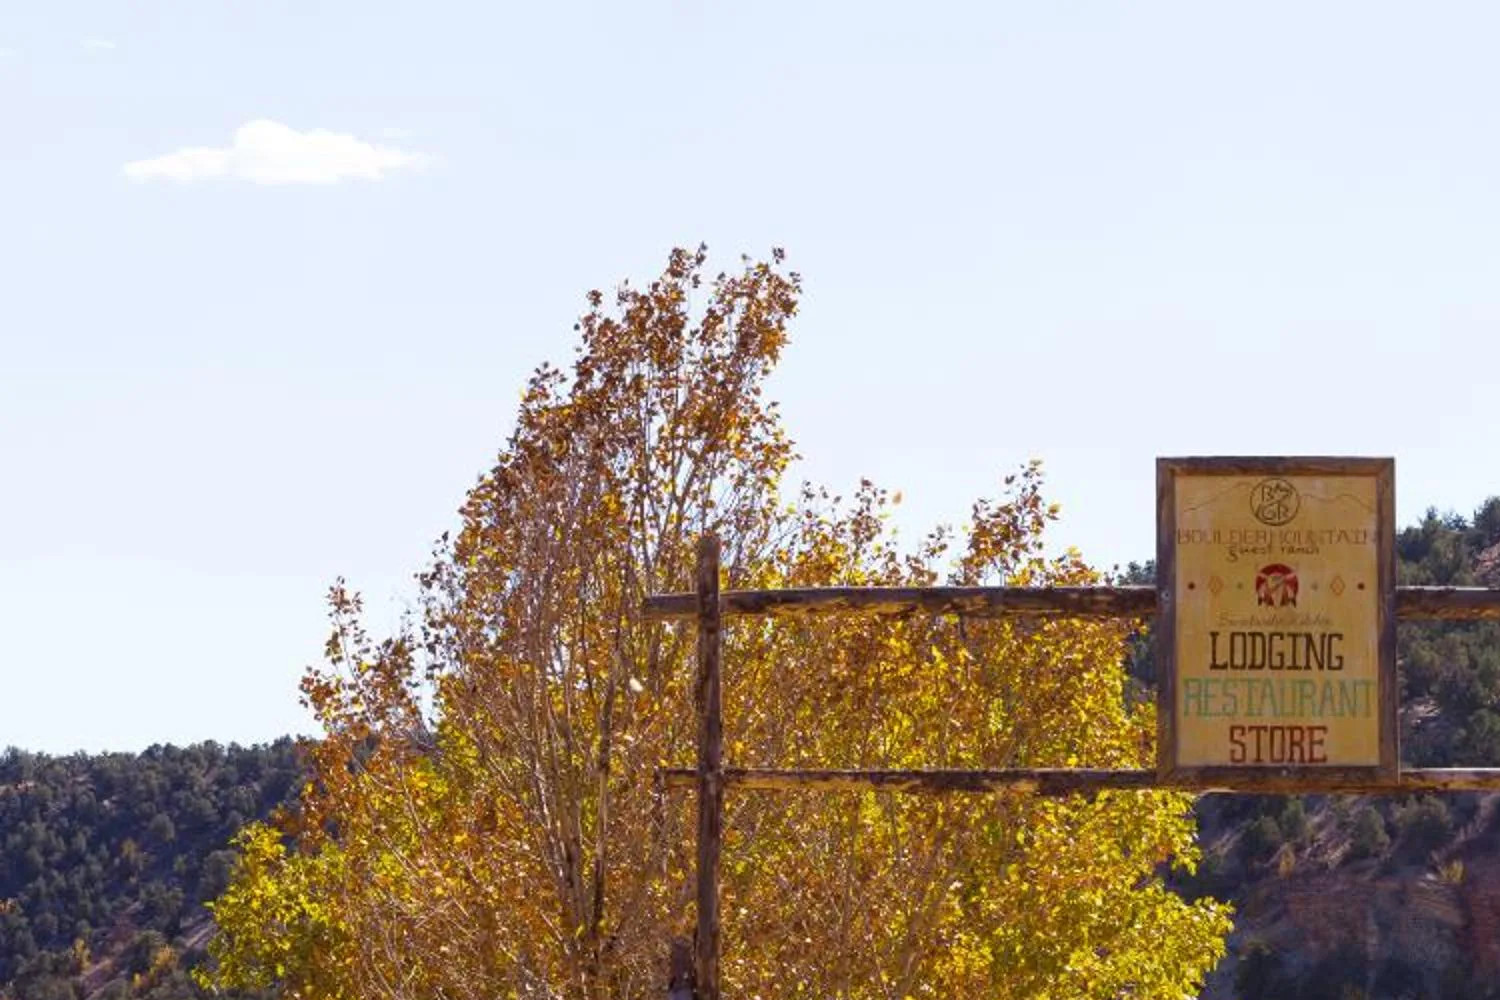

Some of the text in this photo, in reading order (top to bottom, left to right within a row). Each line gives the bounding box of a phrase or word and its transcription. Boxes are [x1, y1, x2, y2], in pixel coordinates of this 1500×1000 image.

[1209, 631, 1344, 670] LODGING
[1183, 677, 1376, 718] RESTAURANT
[1229, 725, 1328, 763] STORE
